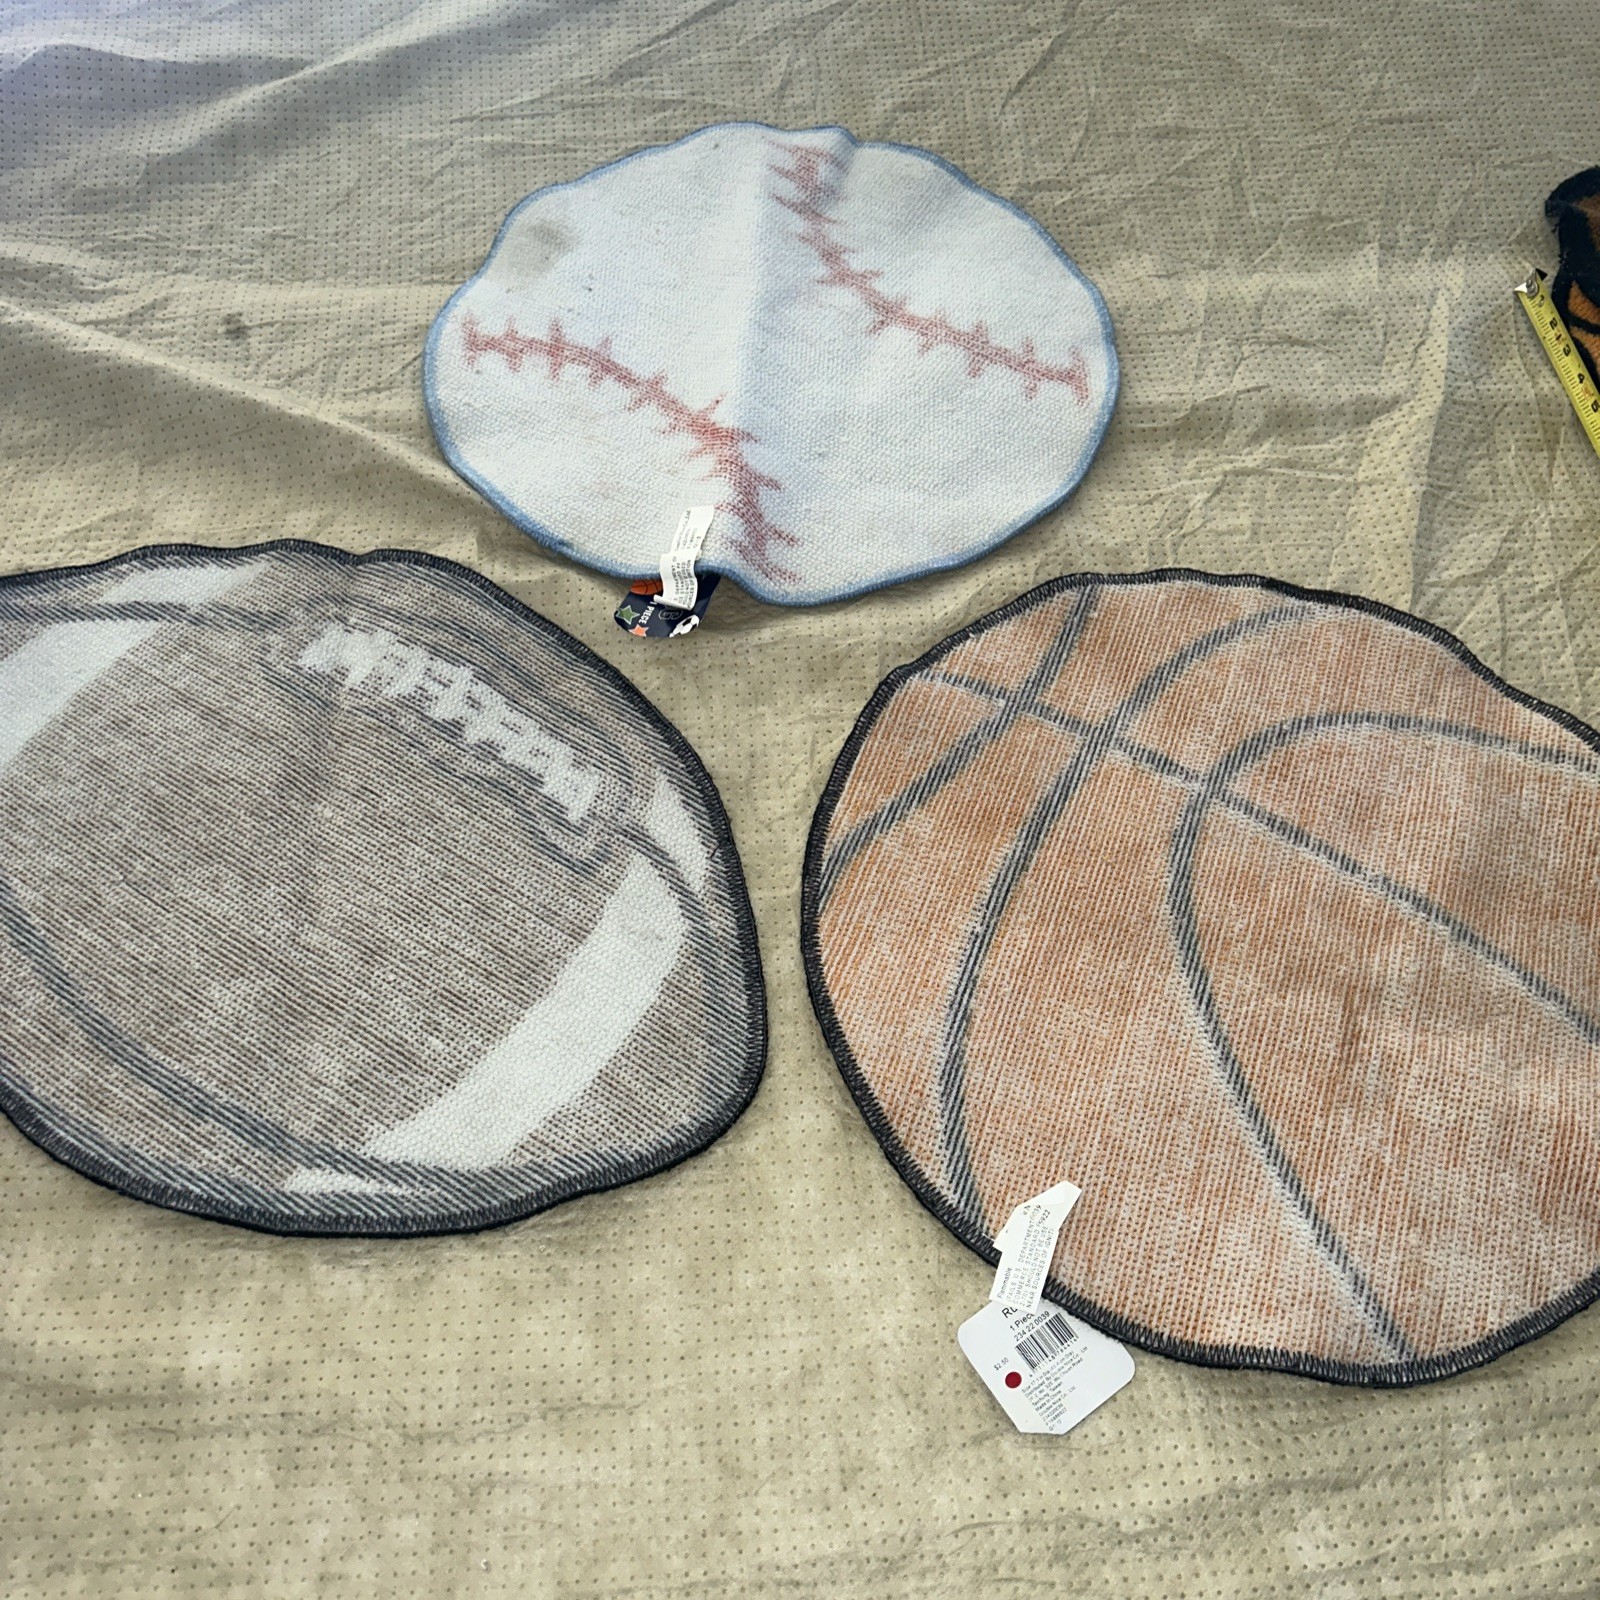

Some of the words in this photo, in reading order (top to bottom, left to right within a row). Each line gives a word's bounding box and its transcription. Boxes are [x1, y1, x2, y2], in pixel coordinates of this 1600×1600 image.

[1549, 318, 1558, 331] 2
[1562, 344, 1572, 357] 3
[1577, 372, 1586, 385] 4
[638, 604, 655, 626] PIECE
[1032, 1248, 1041, 1262] NOT
[1036, 1238, 1044, 1247] BE
[1012, 1267, 1030, 1305] COMMERCE
[1023, 1229, 1041, 1265] STANDARD
[1024, 1262, 1037, 1288] SHOULD
[1025, 1291, 1036, 1309] NEAR
[1031, 1259, 1046, 1290] SOURCES
[1040, 1249, 1048, 1259] OF
[997, 1267, 1013, 1299] Flammable
[1013, 1329, 1027, 1342] 234
[1025, 1322, 1036, 1332] 22
[1033, 1310, 1051, 1326] 0039
[993, 1357, 1009, 1371] $2.50
